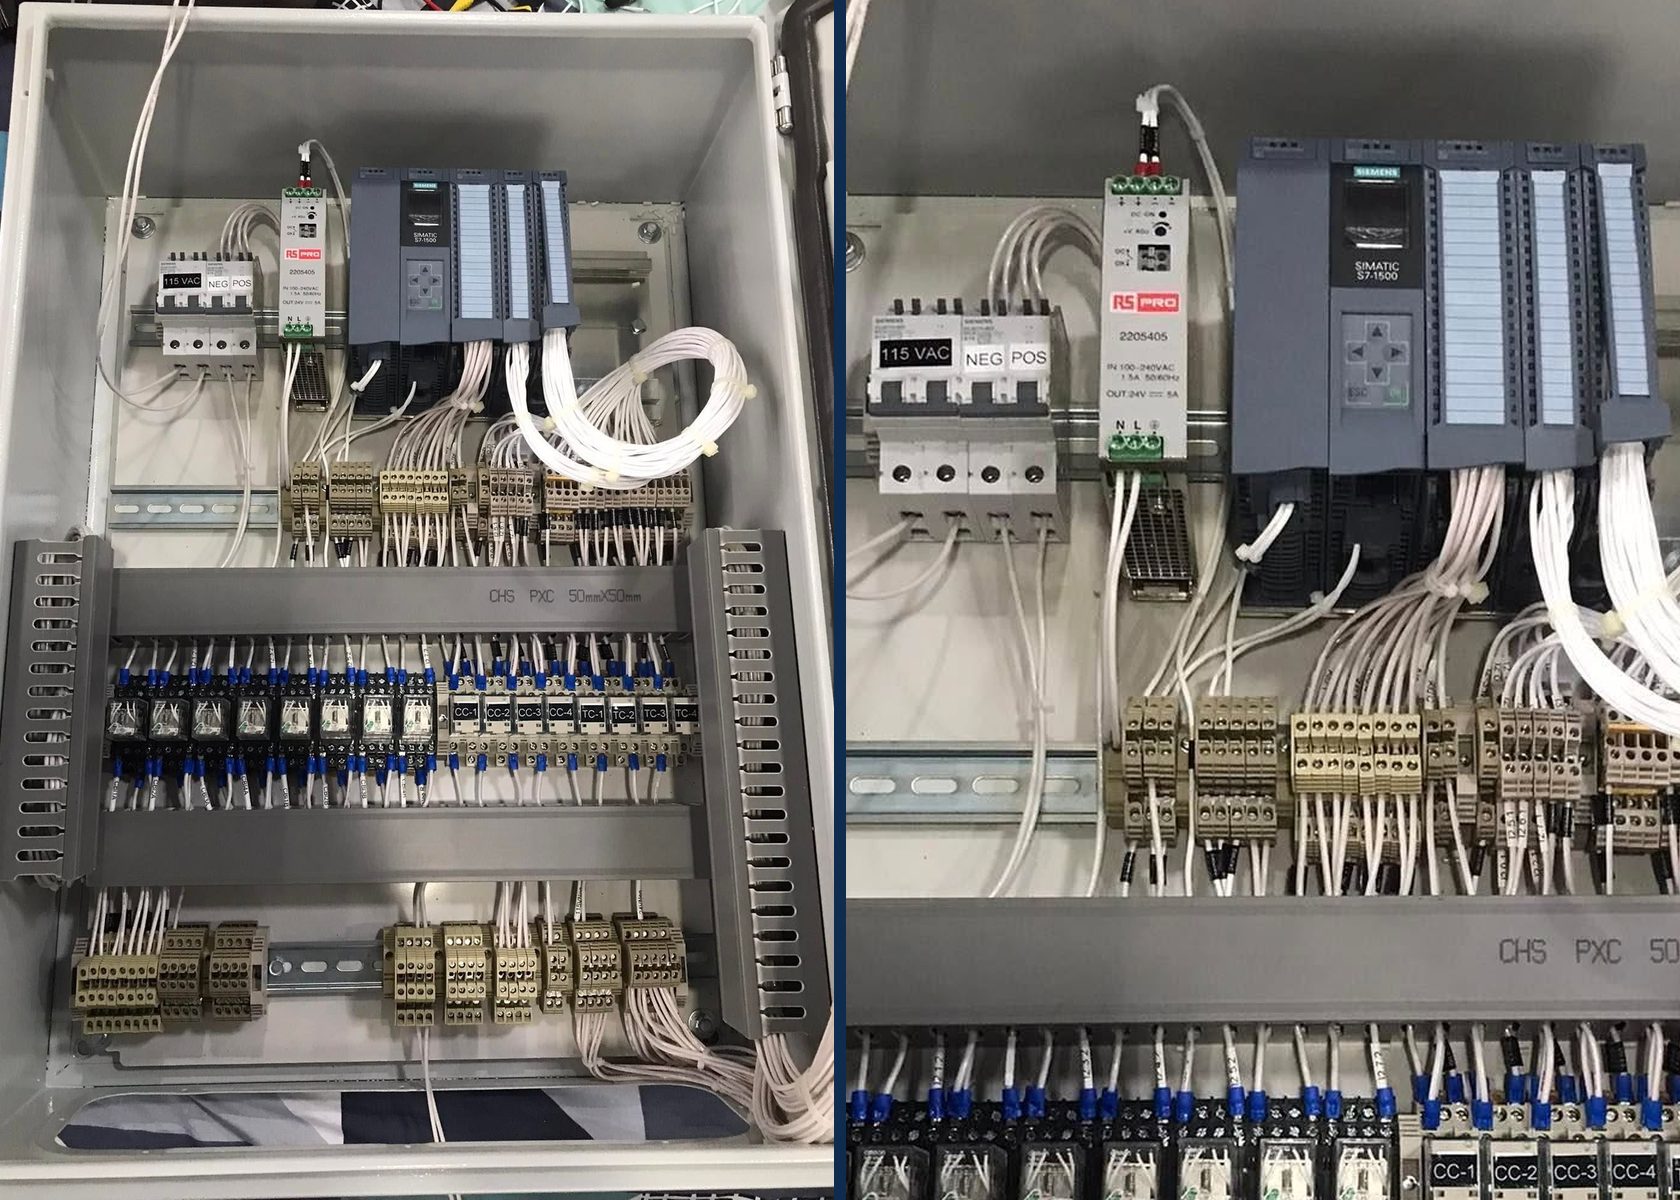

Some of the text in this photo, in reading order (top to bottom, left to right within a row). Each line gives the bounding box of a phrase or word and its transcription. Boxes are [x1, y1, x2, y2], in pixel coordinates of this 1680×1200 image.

[1355, 167, 1399, 177] SIEMENS
[286, 250, 298, 258] RS
[1354, 261, 1400, 272] SIMATIC
[1356, 271, 1398, 281] S7-1500
[164, 277, 201, 286] 115 VAC
[232, 279, 252, 287] POS
[1113, 294, 1178, 310] RS PRO
[1119, 332, 1168, 342] 2205405
[881, 346, 950, 362] 115 VAC
[966, 352, 1003, 366] NEG
[1011, 350, 1048, 365] POS
[1167, 390, 1179, 398] 5A
[1116, 420, 1141, 430] N L
[489, 588, 642, 603] CHS PXC 50mmX50mm
[454, 707, 478, 717] CC-1
[487, 708, 510, 718] CC-2
[518, 708, 542, 718] CC-3
[549, 707, 573, 717] CC-4
[582, 709, 604, 719] TC-1
[612, 710, 636, 720] TC-2
[644, 708, 666, 719] TC-3
[675, 708, 698, 719] TC-4
[1498, 938, 1547, 964] CHS
[1575, 938, 1622, 964] PXC
[1433, 1163, 1477, 1180] CC-1
[1494, 1164, 1538, 1182] CC-2
[1554, 1164, 1598, 1181] CC-3
[1612, 1163, 1656, 1180] CC-4
